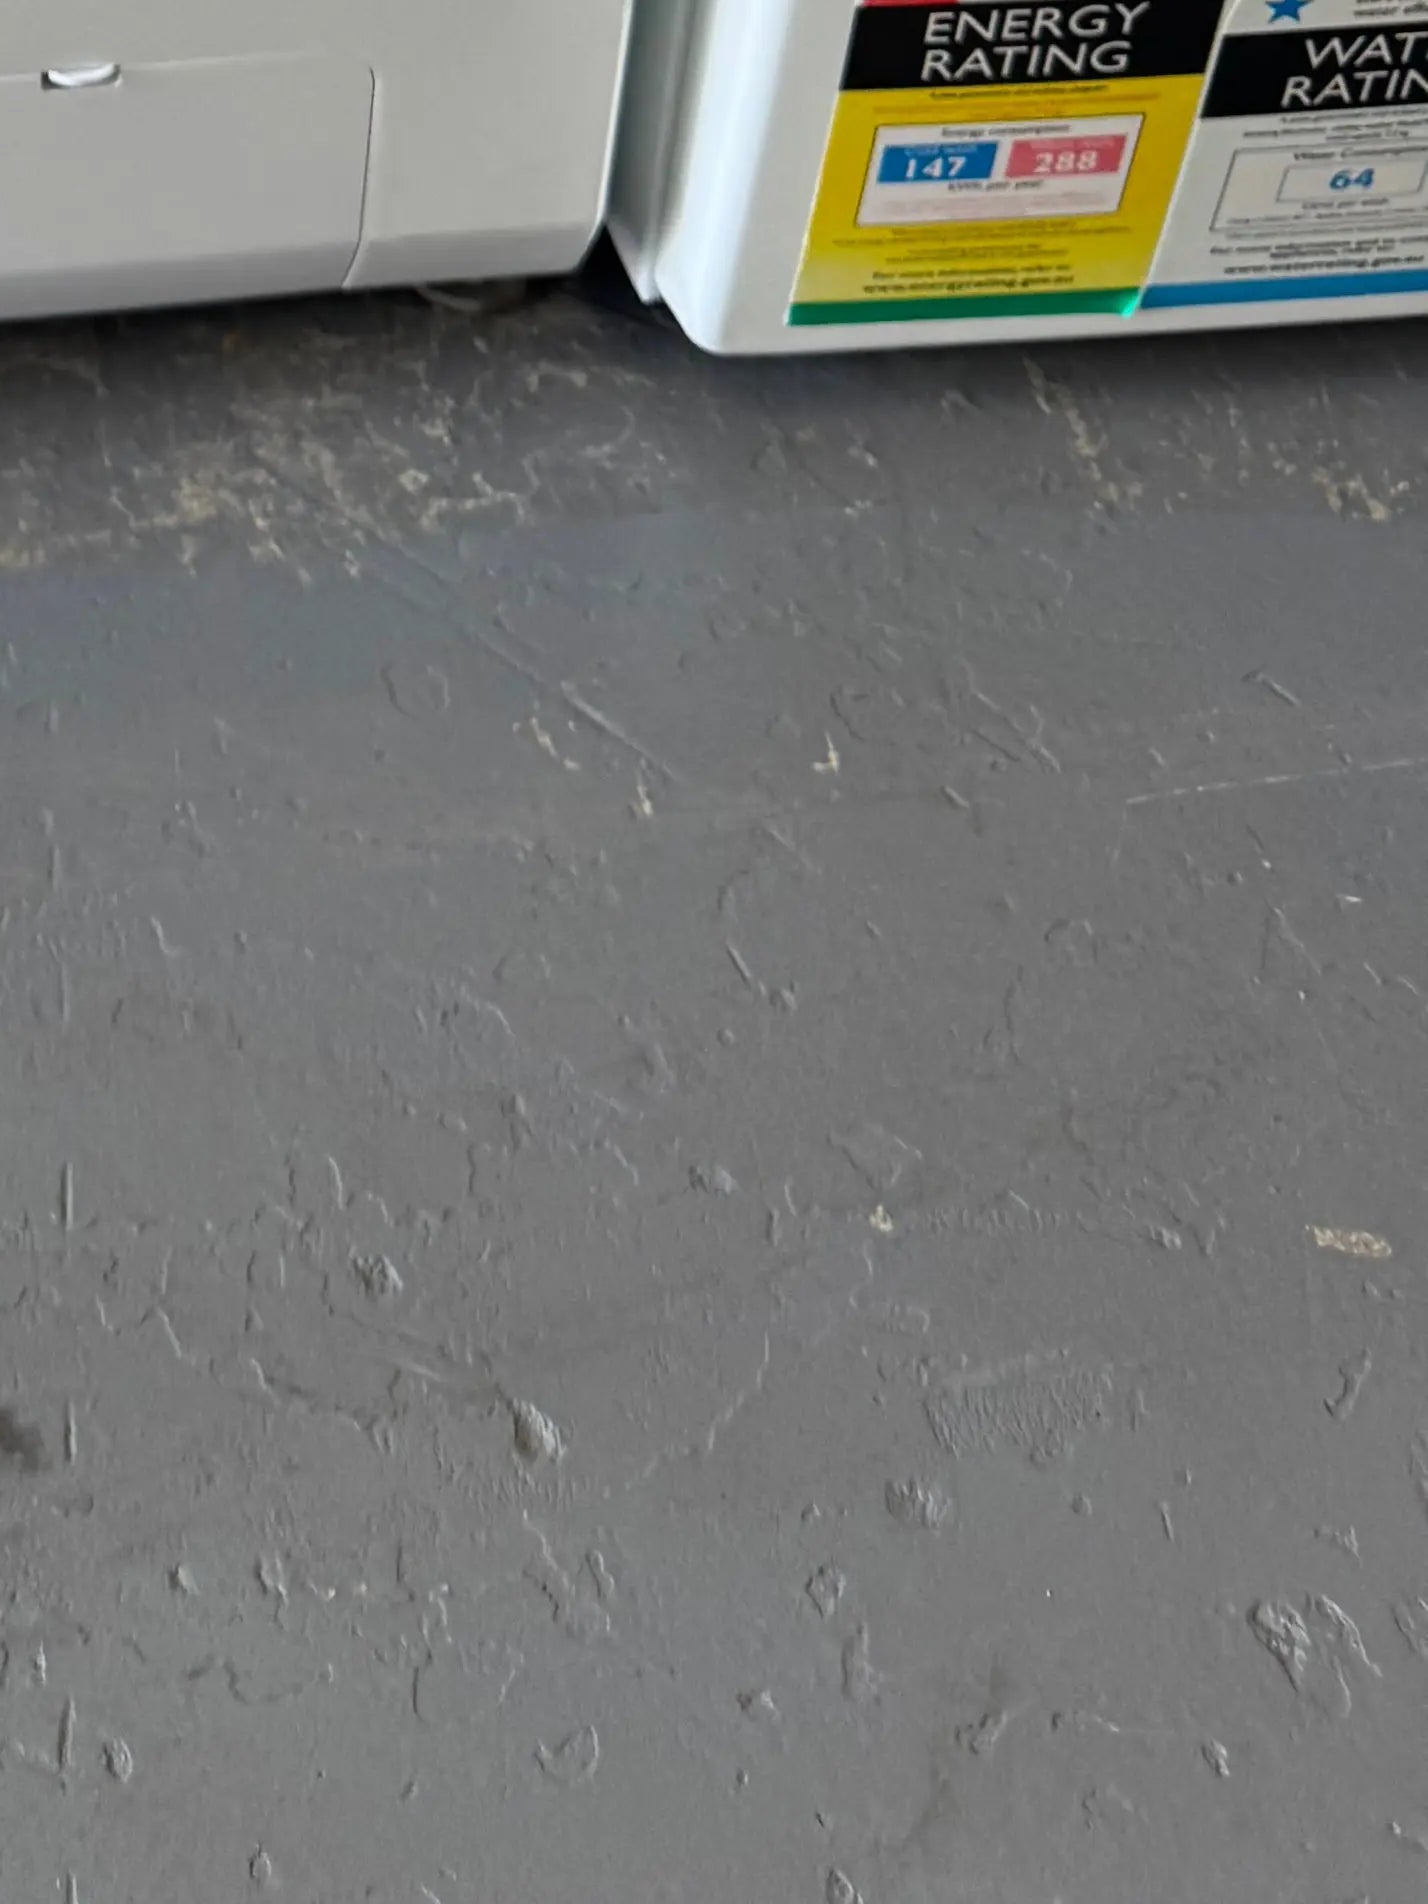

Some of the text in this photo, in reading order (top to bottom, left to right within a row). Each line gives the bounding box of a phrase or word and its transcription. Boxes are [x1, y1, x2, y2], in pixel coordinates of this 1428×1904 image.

[924, 1, 1150, 45] ENERGY
[920, 39, 1133, 82] RATING
[1305, 31, 1428, 70] WAT
[905, 155, 967, 179] 147
[1032, 150, 1098, 174] 288
[1329, 167, 1376, 191] 64
